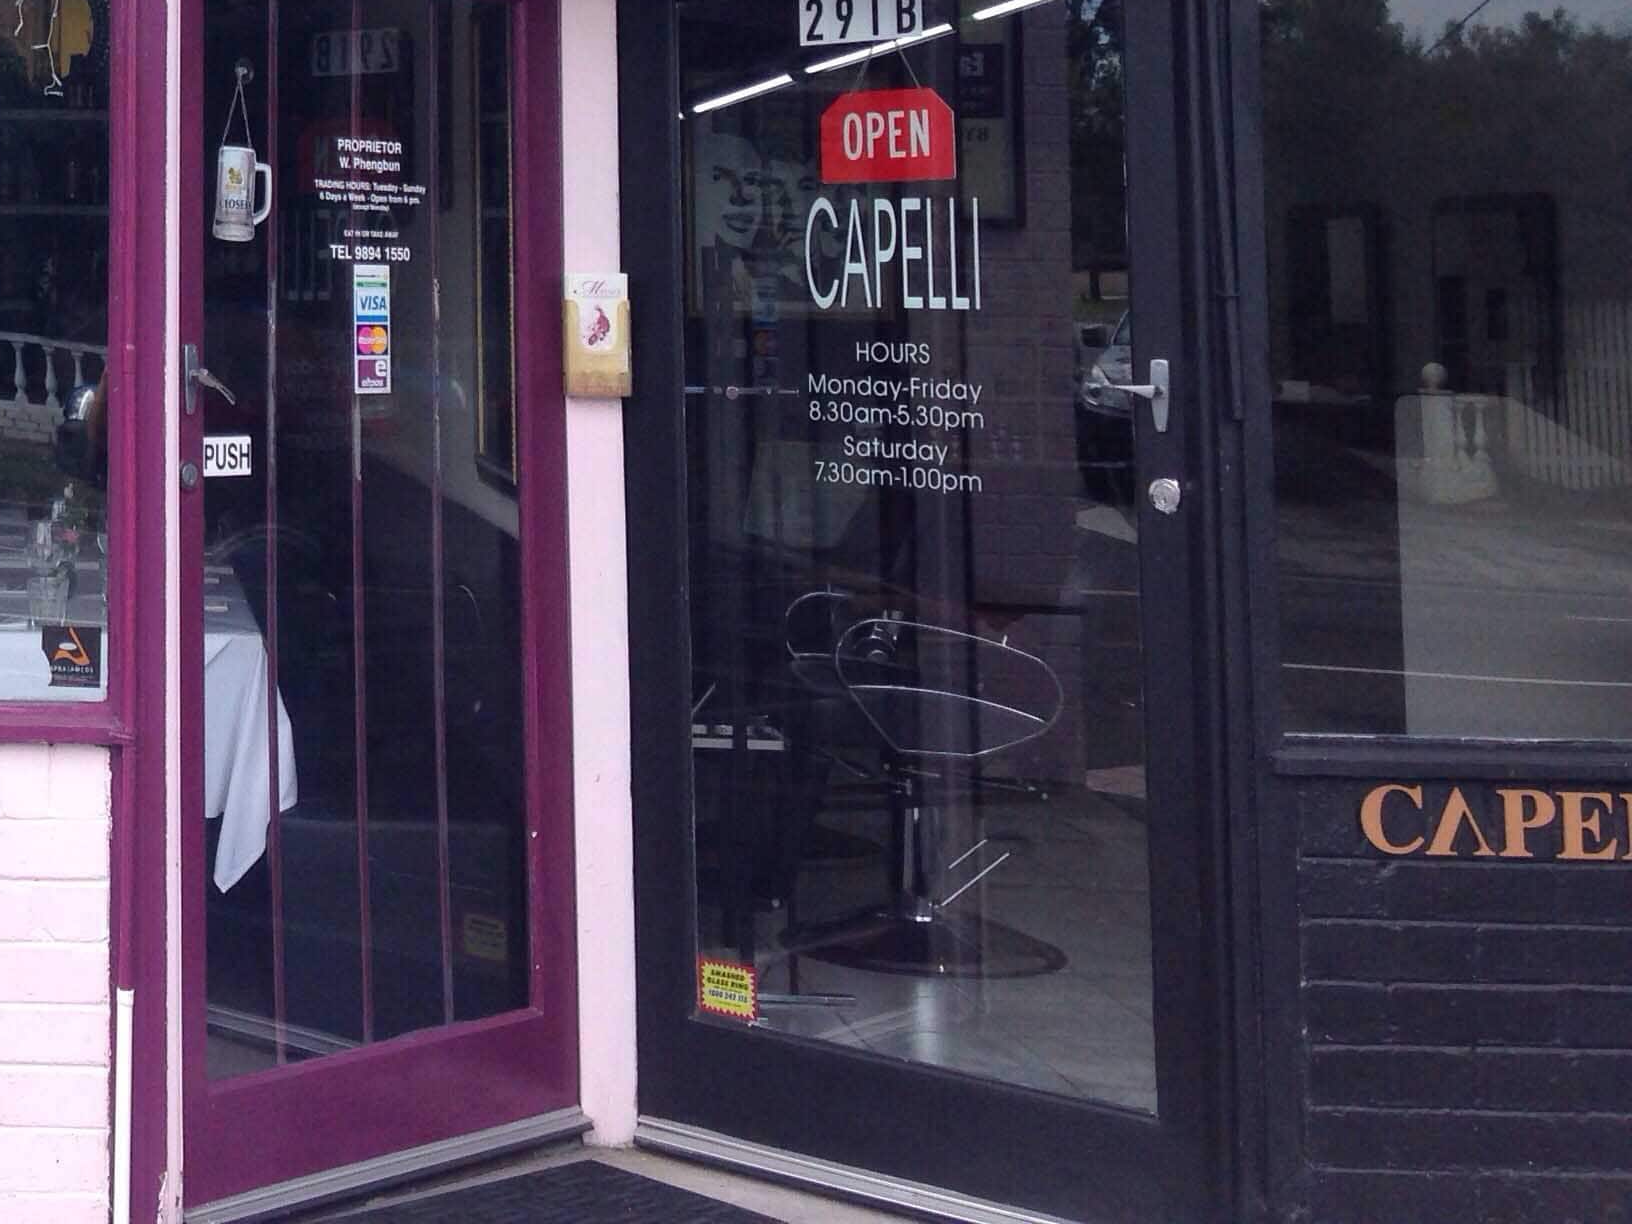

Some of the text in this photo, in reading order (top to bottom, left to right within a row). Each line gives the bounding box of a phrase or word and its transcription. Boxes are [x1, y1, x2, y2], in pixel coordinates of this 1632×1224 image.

[337, 139, 402, 155] PROPRIETOR
[841, 109, 931, 160] OPEN
[314, 179, 345, 190] TRADING
[373, 182, 398, 194] Tuesday
[325, 192, 342, 203] Days
[329, 244, 411, 261] TEL 9894 1550
[805, 196, 981, 310] CAPELLI
[360, 296, 387, 311] VISA
[856, 342, 930, 364] HOURS
[808, 373, 982, 404] Monday-Friday
[809, 401, 984, 431] 8.30am-5.30pm
[205, 443, 250, 470] PUSH
[843, 435, 948, 466] Saturday
[815, 461, 982, 494] 7.30am-1.00pm
[1360, 783, 1631, 861] CAPE
